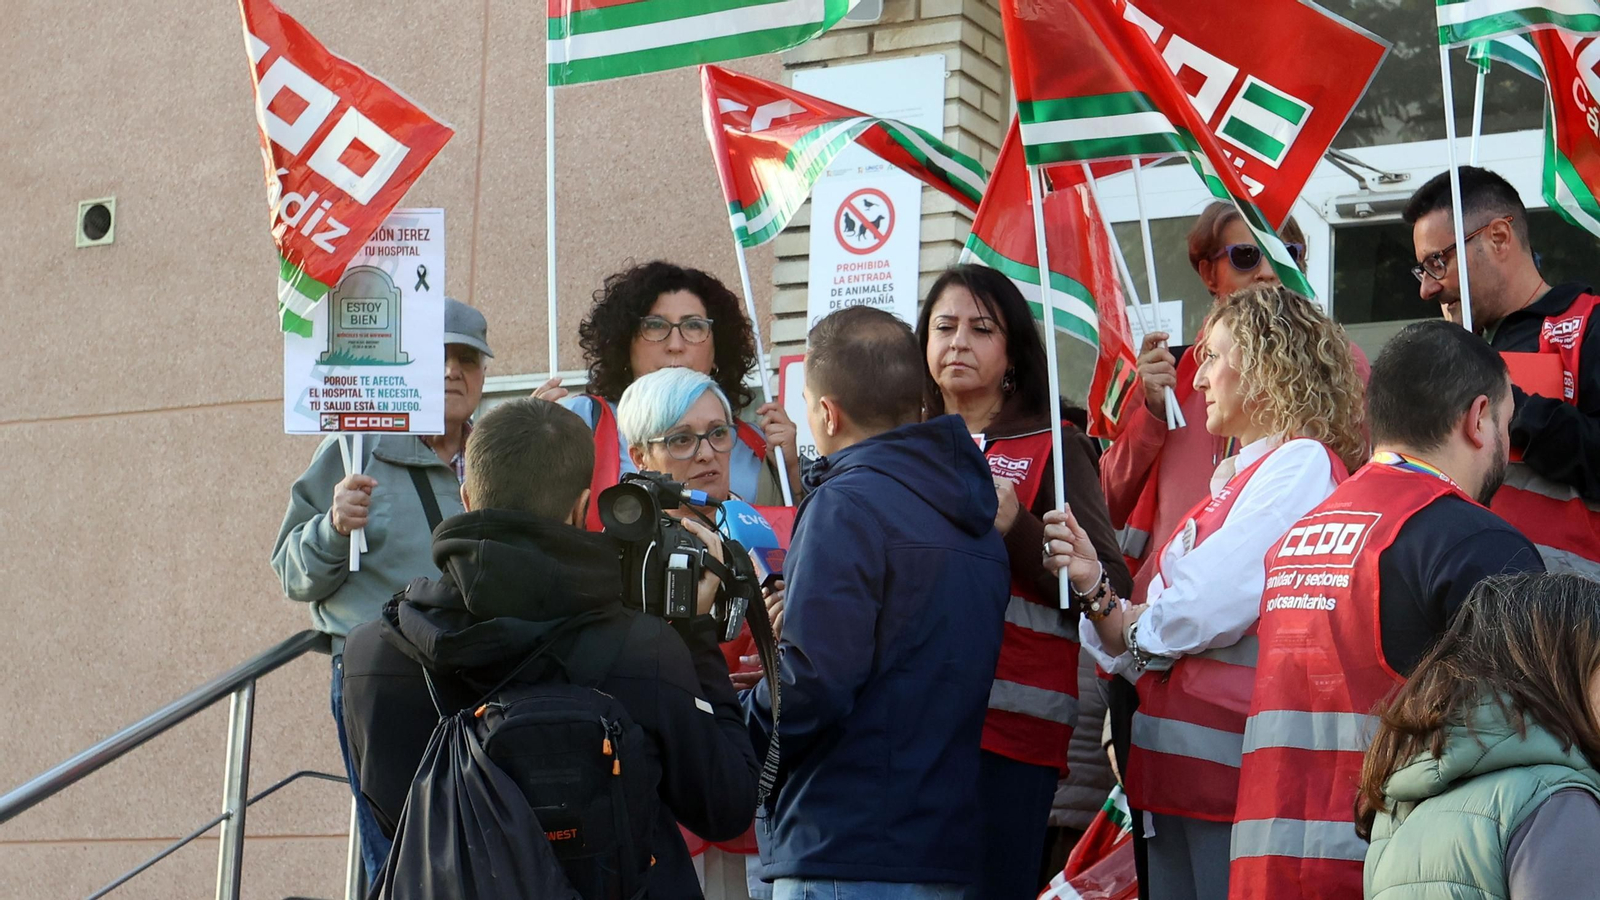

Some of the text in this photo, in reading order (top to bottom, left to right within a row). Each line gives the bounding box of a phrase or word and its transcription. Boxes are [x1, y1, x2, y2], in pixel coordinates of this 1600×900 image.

[397, 228, 431, 242] JEREZ
[377, 245, 420, 256] HOSPITAL
[836, 260, 890, 272] PROHIBIDA
[833, 271, 892, 285] LA ENTRADA
[831, 283, 894, 297] DE ANIMALES
[346, 302, 382, 313] ESTOY
[829, 299, 842, 309] DE
[844, 293, 895, 308] COMPAÑÍA
[350, 314, 377, 325] BIEN
[324, 376, 407, 387] PORQUE TE AFECTA,
[309, 388, 422, 400] EL HOSPITAL TE NECESITA,
[310, 398, 421, 411] TU SALUD ESTÁ EN JUEGO.
[344, 417, 393, 428] CCOO
[799, 445, 818, 457] PR
[988, 457, 1028, 470] CCOO
[738, 512, 772, 530] tve
[1278, 523, 1366, 558] CCOO
[1266, 571, 1297, 590] anidad
[1293, 574, 1303, 589] y
